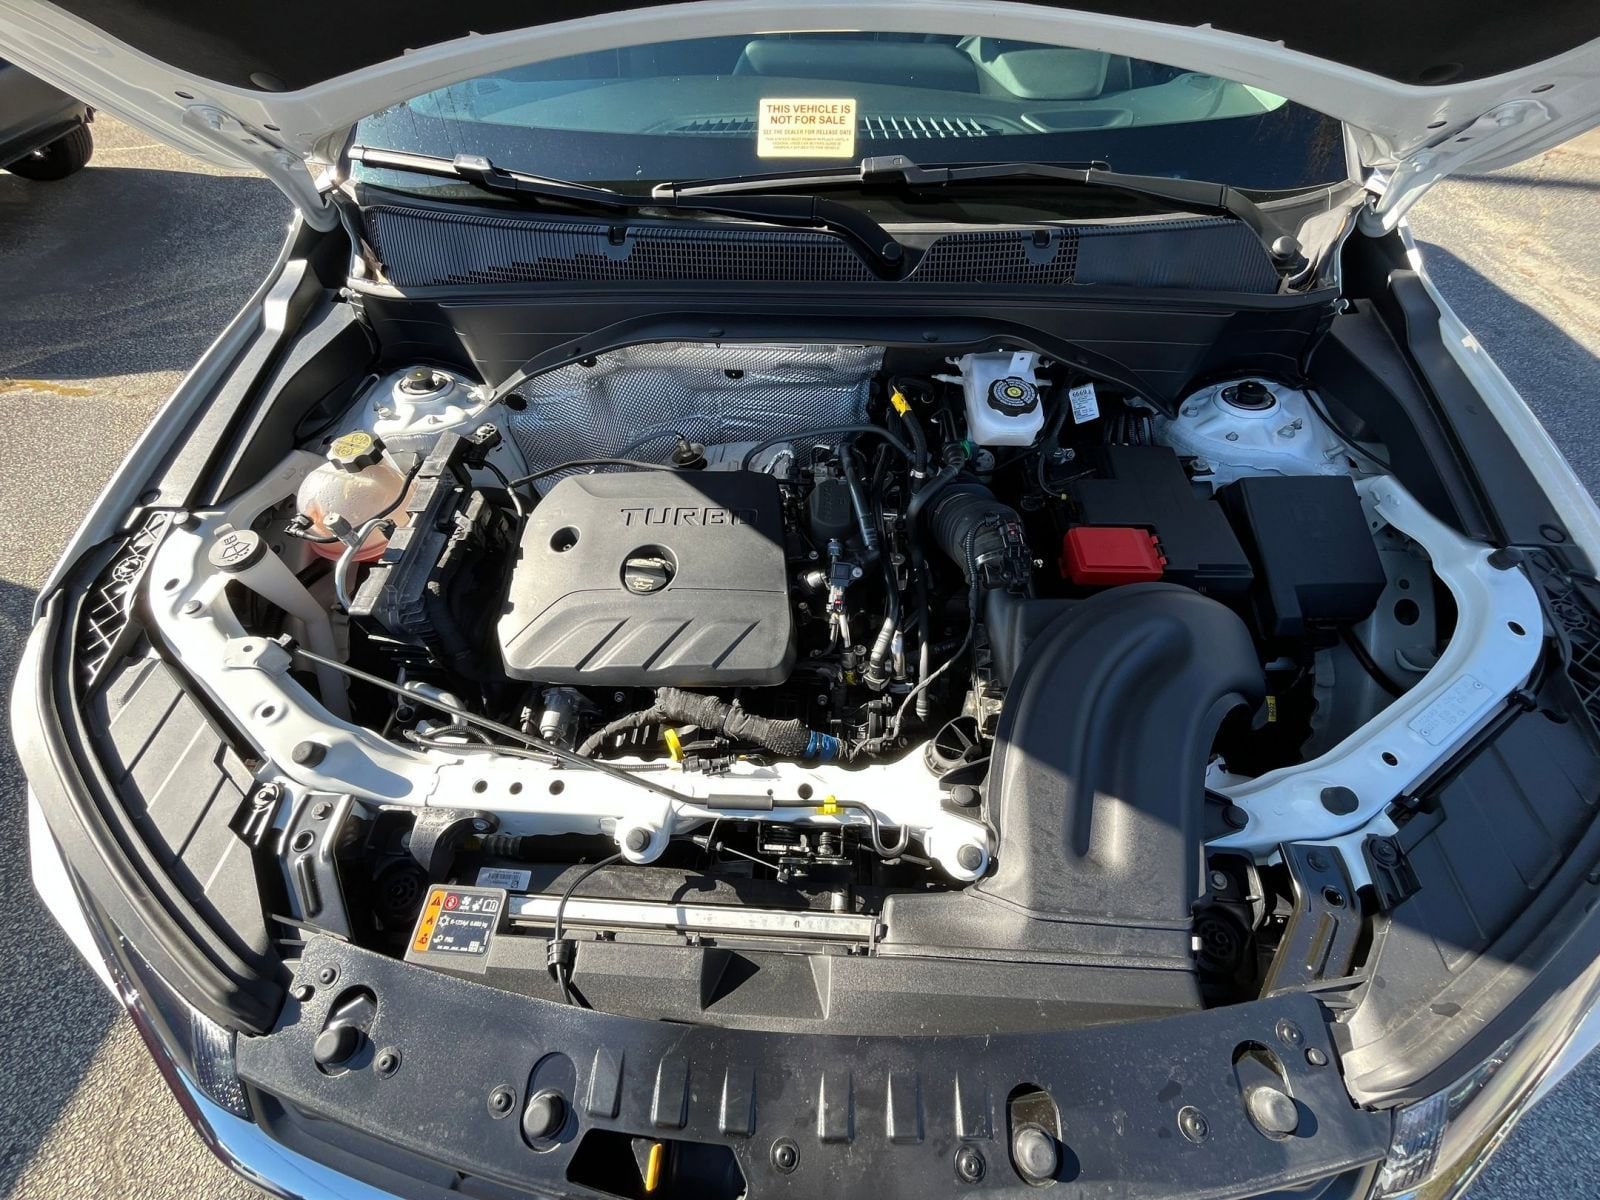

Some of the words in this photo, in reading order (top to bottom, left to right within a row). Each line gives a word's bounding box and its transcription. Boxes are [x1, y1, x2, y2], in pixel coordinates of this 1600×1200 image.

[767, 104, 791, 114] THIS
[793, 104, 838, 114] VEHICLE
[841, 104, 851, 114] IS
[770, 115, 792, 125] NOT
[794, 115, 816, 125] FOR
[819, 115, 846, 125] SALE
[620, 507, 758, 527] TURBO
